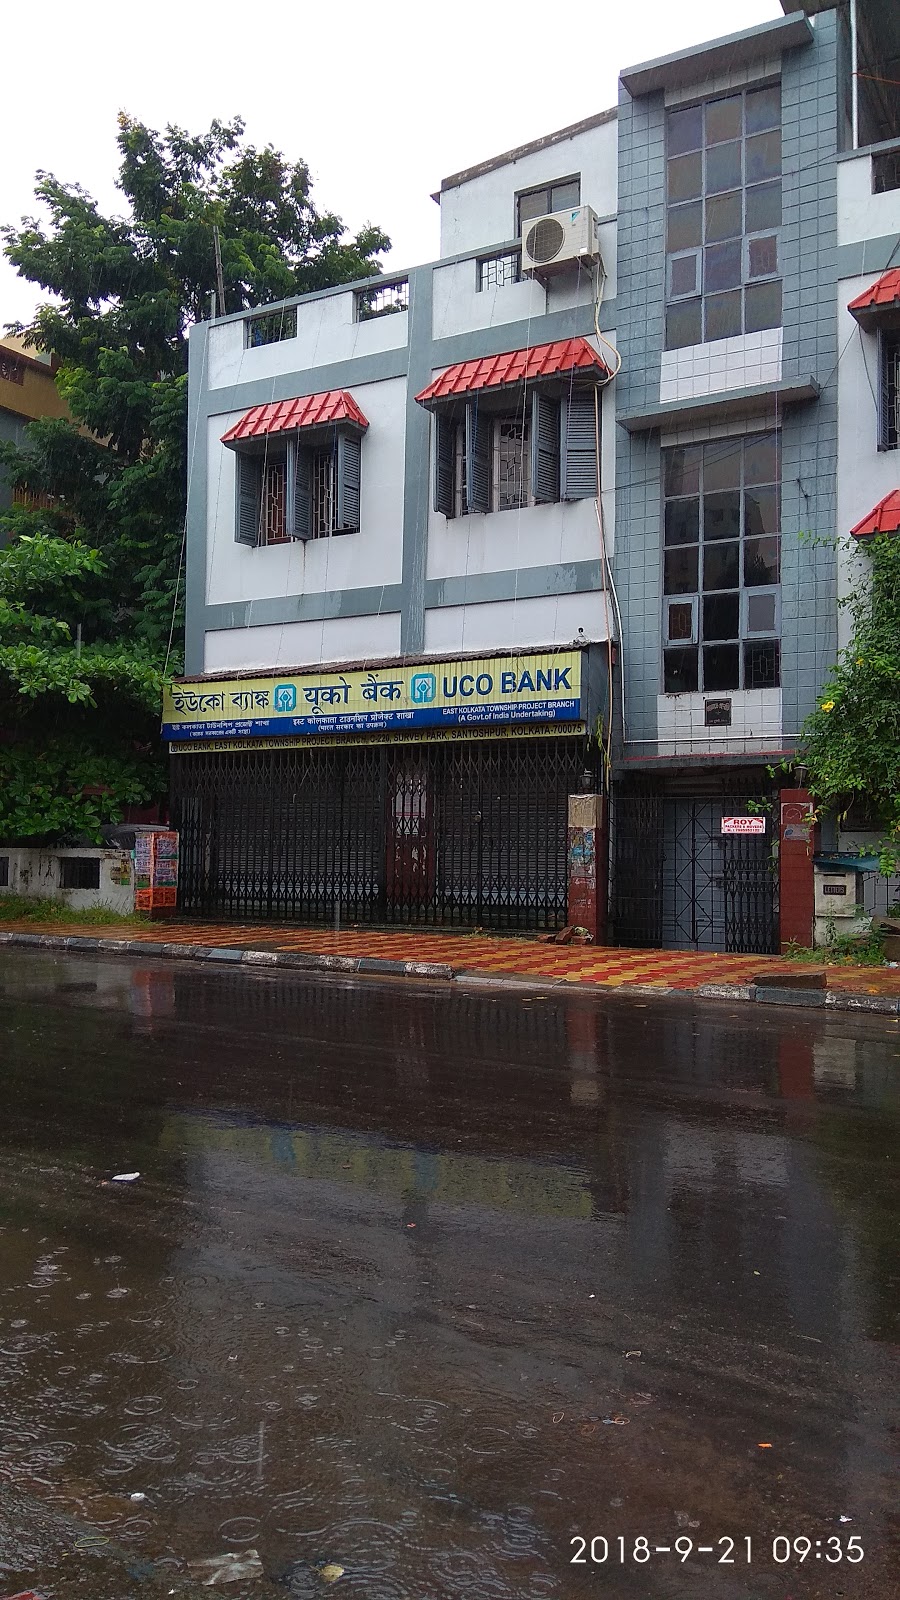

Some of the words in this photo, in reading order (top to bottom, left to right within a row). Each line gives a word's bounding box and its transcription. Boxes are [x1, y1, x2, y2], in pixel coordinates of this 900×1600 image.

[443, 673, 493, 698] UCO
[501, 667, 572, 693] BANK
[302, 676, 352, 714] यूको
[360, 673, 404, 702] बैंक
[172, 689, 225, 715] ইউকো
[229, 689, 270, 711] ব্যাঙ্ক
[442, 707, 458, 715] EAST
[458, 706, 486, 714] KOLKATA
[487, 703, 517, 713] TOWNSHIP
[519, 702, 547, 711] PROJECT
[547, 700, 575, 709] BRANCH
[307, 715, 337, 725] कोलकाता
[339, 713, 368, 723] टाउनशिप
[370, 712, 394, 721] प्रोजेक्ट
[396, 711, 414, 720] शाखा
[493, 711, 510, 720] India
[511, 709, 556, 719] Undertaking)
[206, 720, 233, 729] টাউনশিপ
[318, 724, 334, 732] (भारत
[336, 723, 354, 731] सरकार
[179, 744, 192, 752] UCO
[193, 743, 213, 751] BANK,
[214, 742, 231, 750] EAST
[233, 740, 263, 749] KOLKATA
[265, 738, 301, 748] TOWNSHIP
[302, 736, 334, 746] PROJECT
[336, 735, 367, 745] BRANCH,
[394, 732, 424, 742] SURVEY
[426, 731, 450, 741] PARK,
[452, 728, 509, 739] SANTOSHPUR,
[511, 723, 582, 737] KOLKATA-700075
